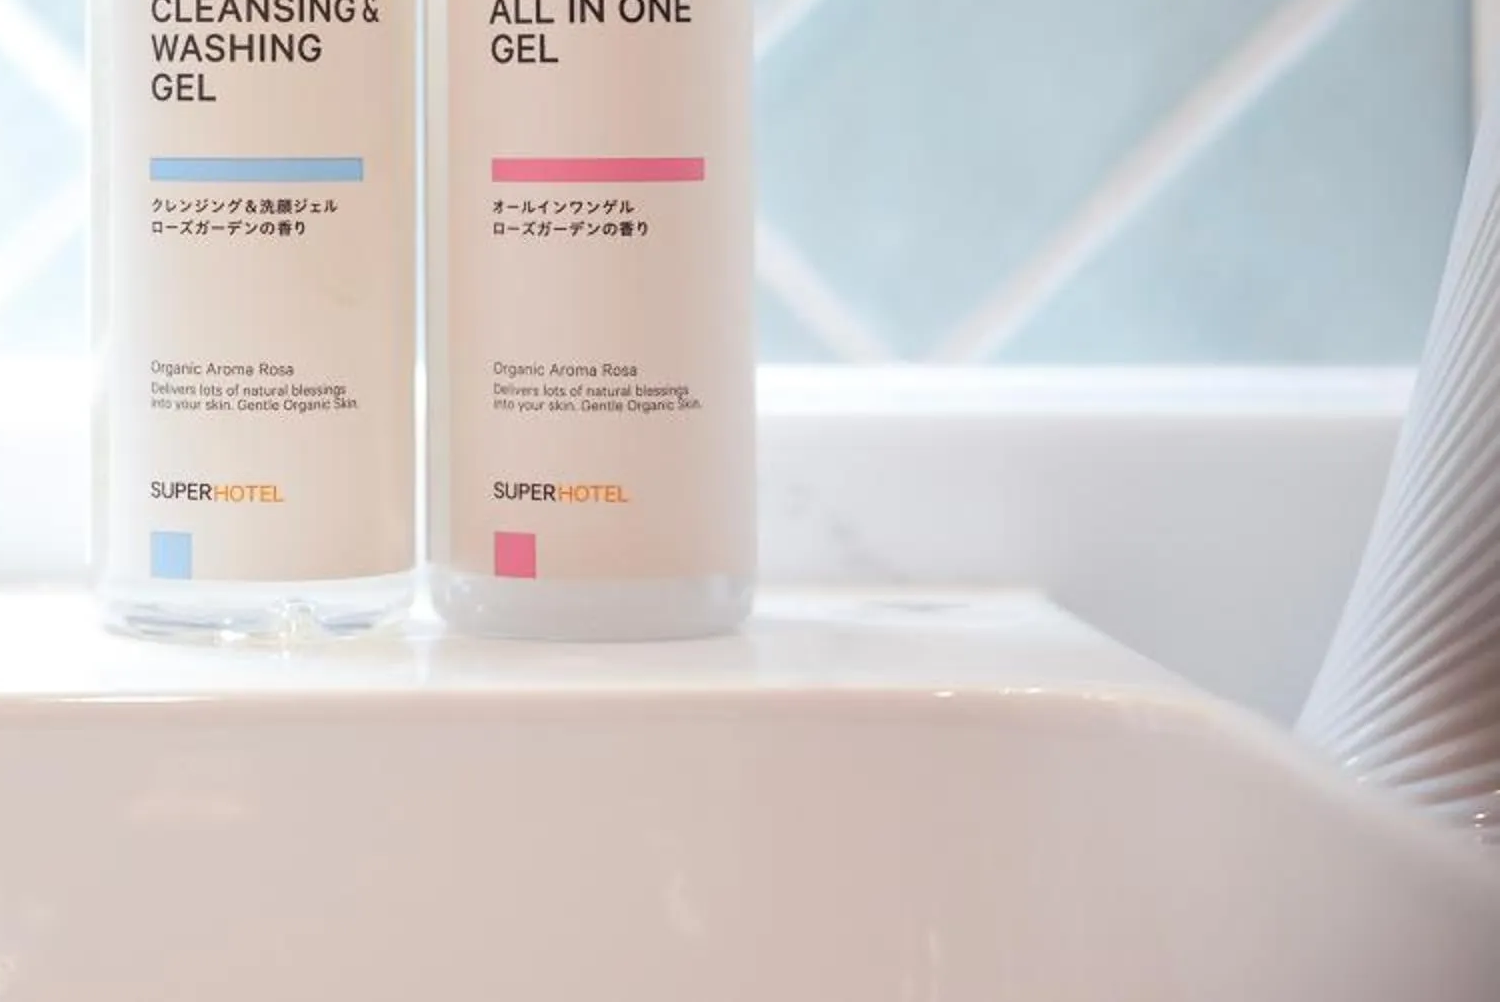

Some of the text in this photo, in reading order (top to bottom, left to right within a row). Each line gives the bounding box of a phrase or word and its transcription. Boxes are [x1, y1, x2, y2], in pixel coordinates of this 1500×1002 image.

[151, 33, 323, 63] WASHING
[491, 33, 559, 64] GEL
[151, 73, 217, 102] GEL
[492, 199, 636, 215] オールインワンゲル
[151, 220, 307, 237] ローズガーデンの香り
[492, 220, 649, 237] ローズガーデンの香り
[150, 360, 295, 377] Organic Aroma Rosa
[493, 362, 638, 378] Organic Aroma Rosa
[151, 382, 347, 398] Delivers lots of natural blessings
[493, 382, 689, 398] Delivers lots of natural blessings
[174, 399, 201, 412] your
[237, 398, 280, 411] Gentle
[283, 398, 331, 414] Organic
[517, 400, 545, 413] your
[581, 399, 624, 412] Gentle
[627, 399, 675, 414] Organic
